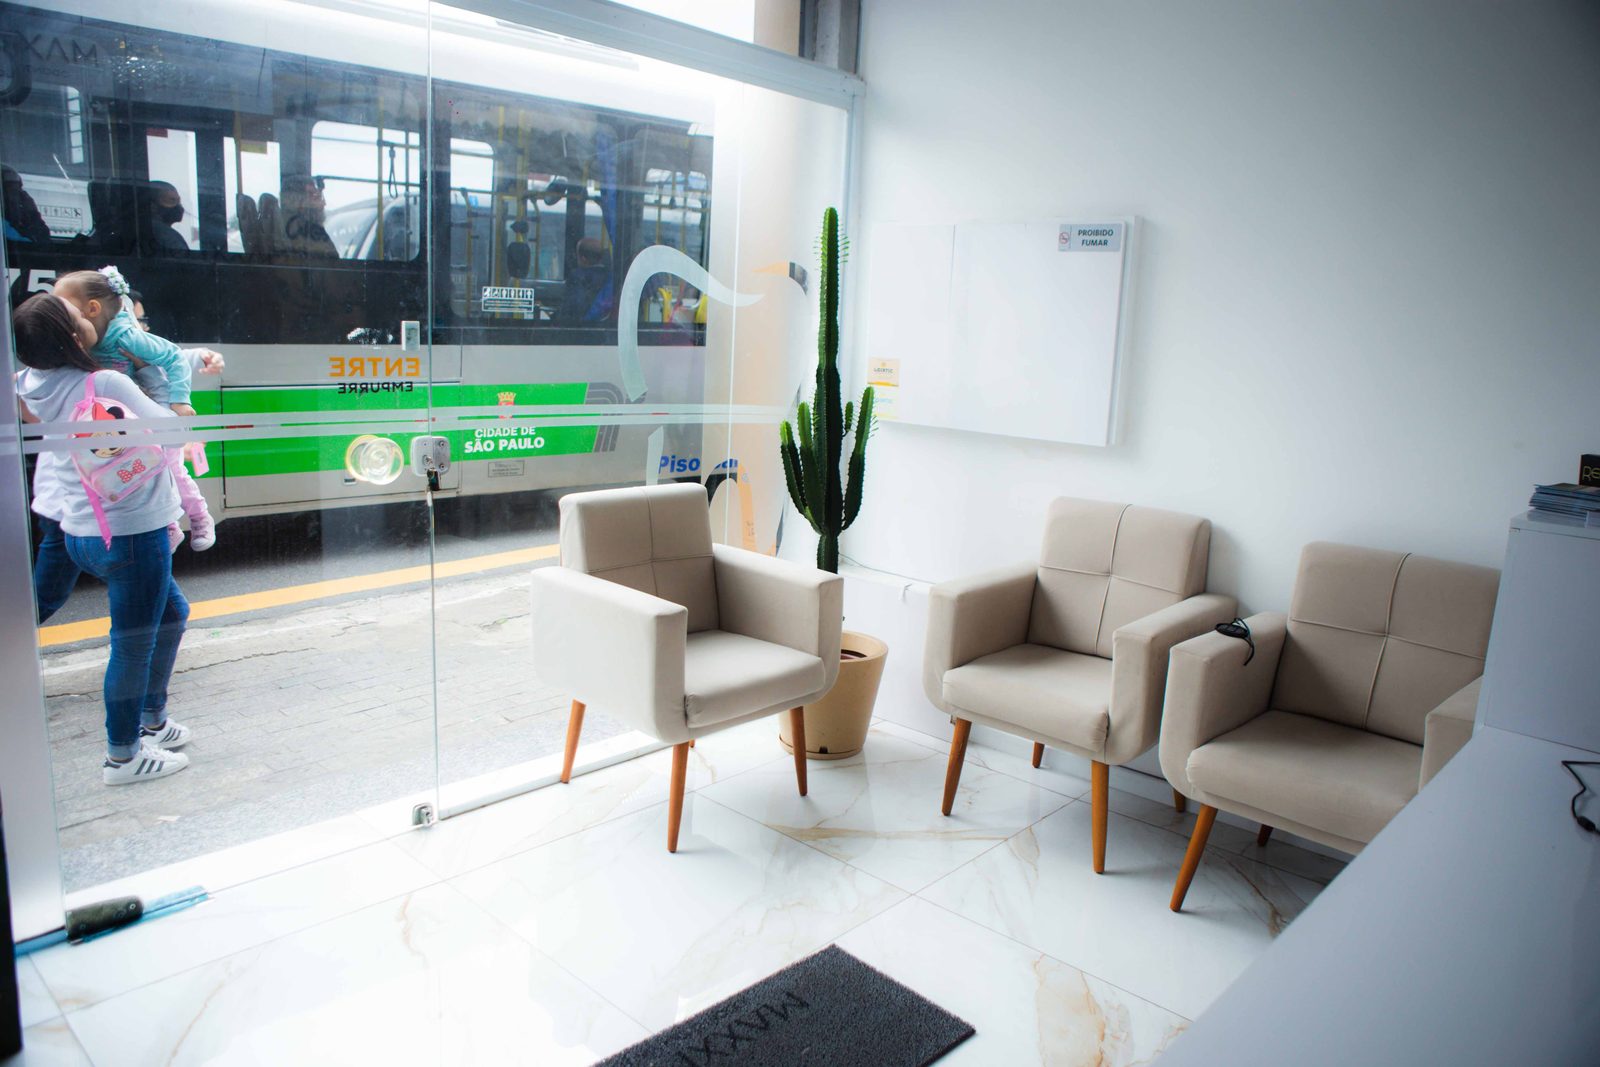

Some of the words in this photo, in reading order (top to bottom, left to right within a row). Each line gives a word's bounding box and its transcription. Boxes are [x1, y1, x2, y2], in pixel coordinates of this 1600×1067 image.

[1078, 229, 1114, 237] PROIBIDO
[1081, 239, 1108, 247] FUMAR
[474, 427, 518, 438] CIDADE
[521, 426, 536, 435] DE
[464, 438, 495, 453] SÃO
[498, 437, 545, 451] PAULO
[658, 454, 701, 474] Piso
